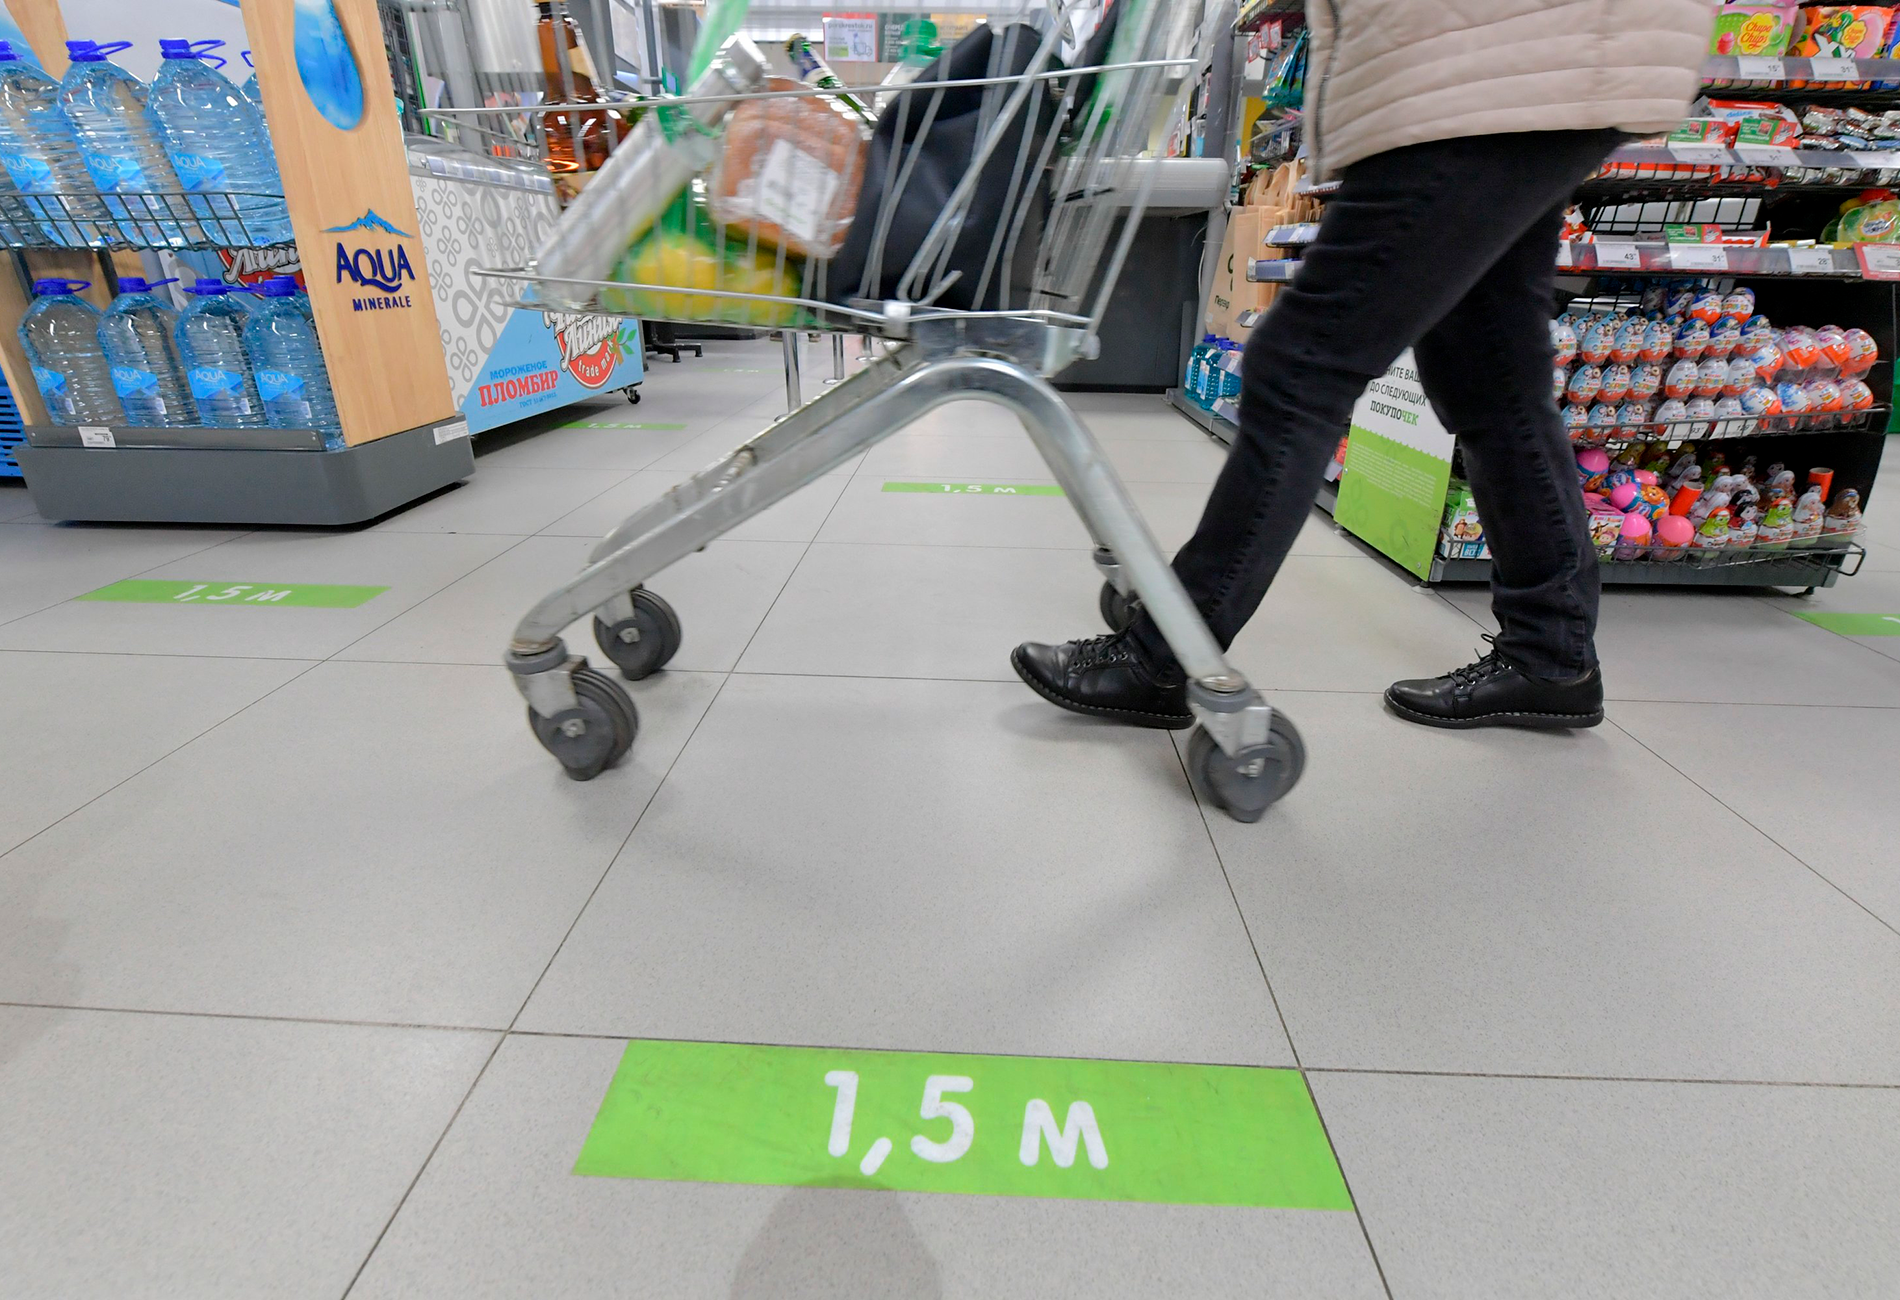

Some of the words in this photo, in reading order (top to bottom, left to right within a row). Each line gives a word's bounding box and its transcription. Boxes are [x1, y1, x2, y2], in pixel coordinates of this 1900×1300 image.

[336, 242, 416, 293] AQUA
[352, 295, 412, 312] MINERALE
[195, 370, 226, 382] AQUA
[489, 361, 548, 381] МОРОЖЕНОЕ
[578, 360, 599, 377] trade
[1386, 366, 1405, 379] НИТЕ
[261, 372, 288, 385] AQUA
[478, 369, 559, 408] ПЛОМБИР
[1370, 381, 1380, 393] ДО
[1380, 384, 1427, 407] СЛЕДУЮЩИХ
[1370, 400, 1419, 426] ПОКУПОЧЕК
[941, 484, 982, 493] 1,5
[173, 585, 253, 602] 1,5
[824, 1070, 975, 1175] 1,5
